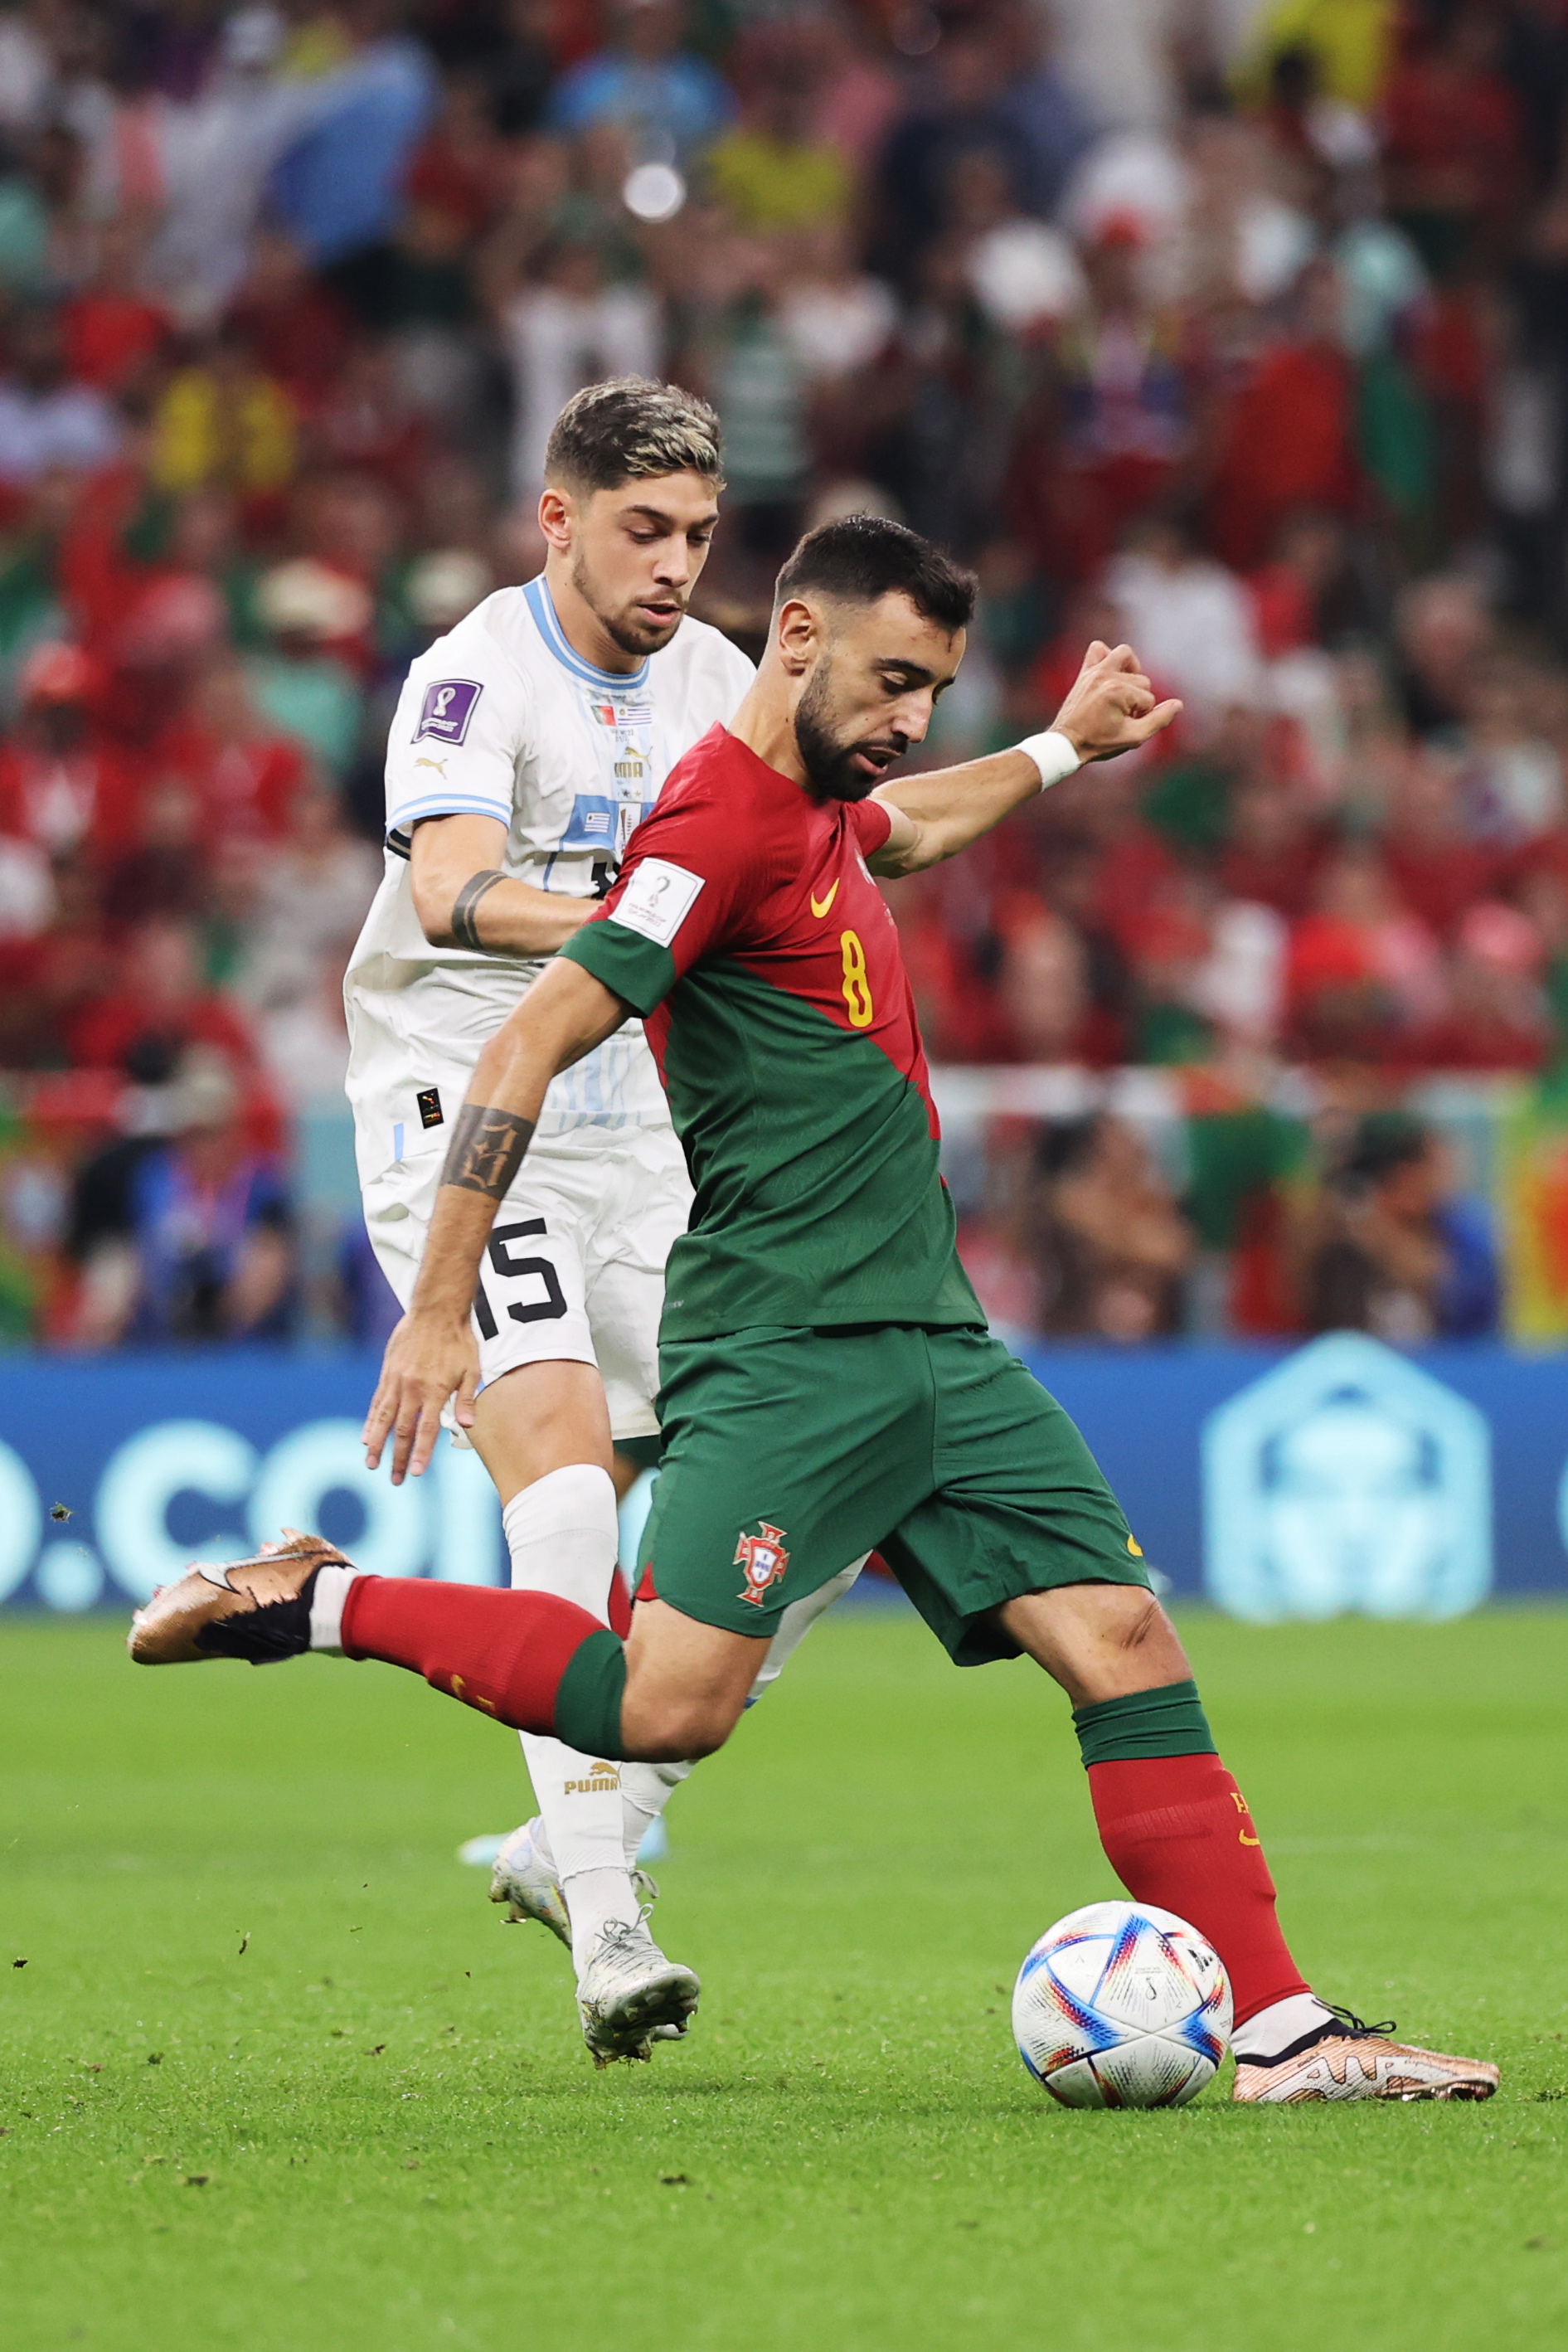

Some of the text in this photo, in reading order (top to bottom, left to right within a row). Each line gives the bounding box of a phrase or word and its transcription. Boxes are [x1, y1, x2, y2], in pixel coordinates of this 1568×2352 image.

[840, 930, 873, 1028] 8
[471, 1217, 568, 1341] 15
[565, 1776, 618, 1795] PUMA
